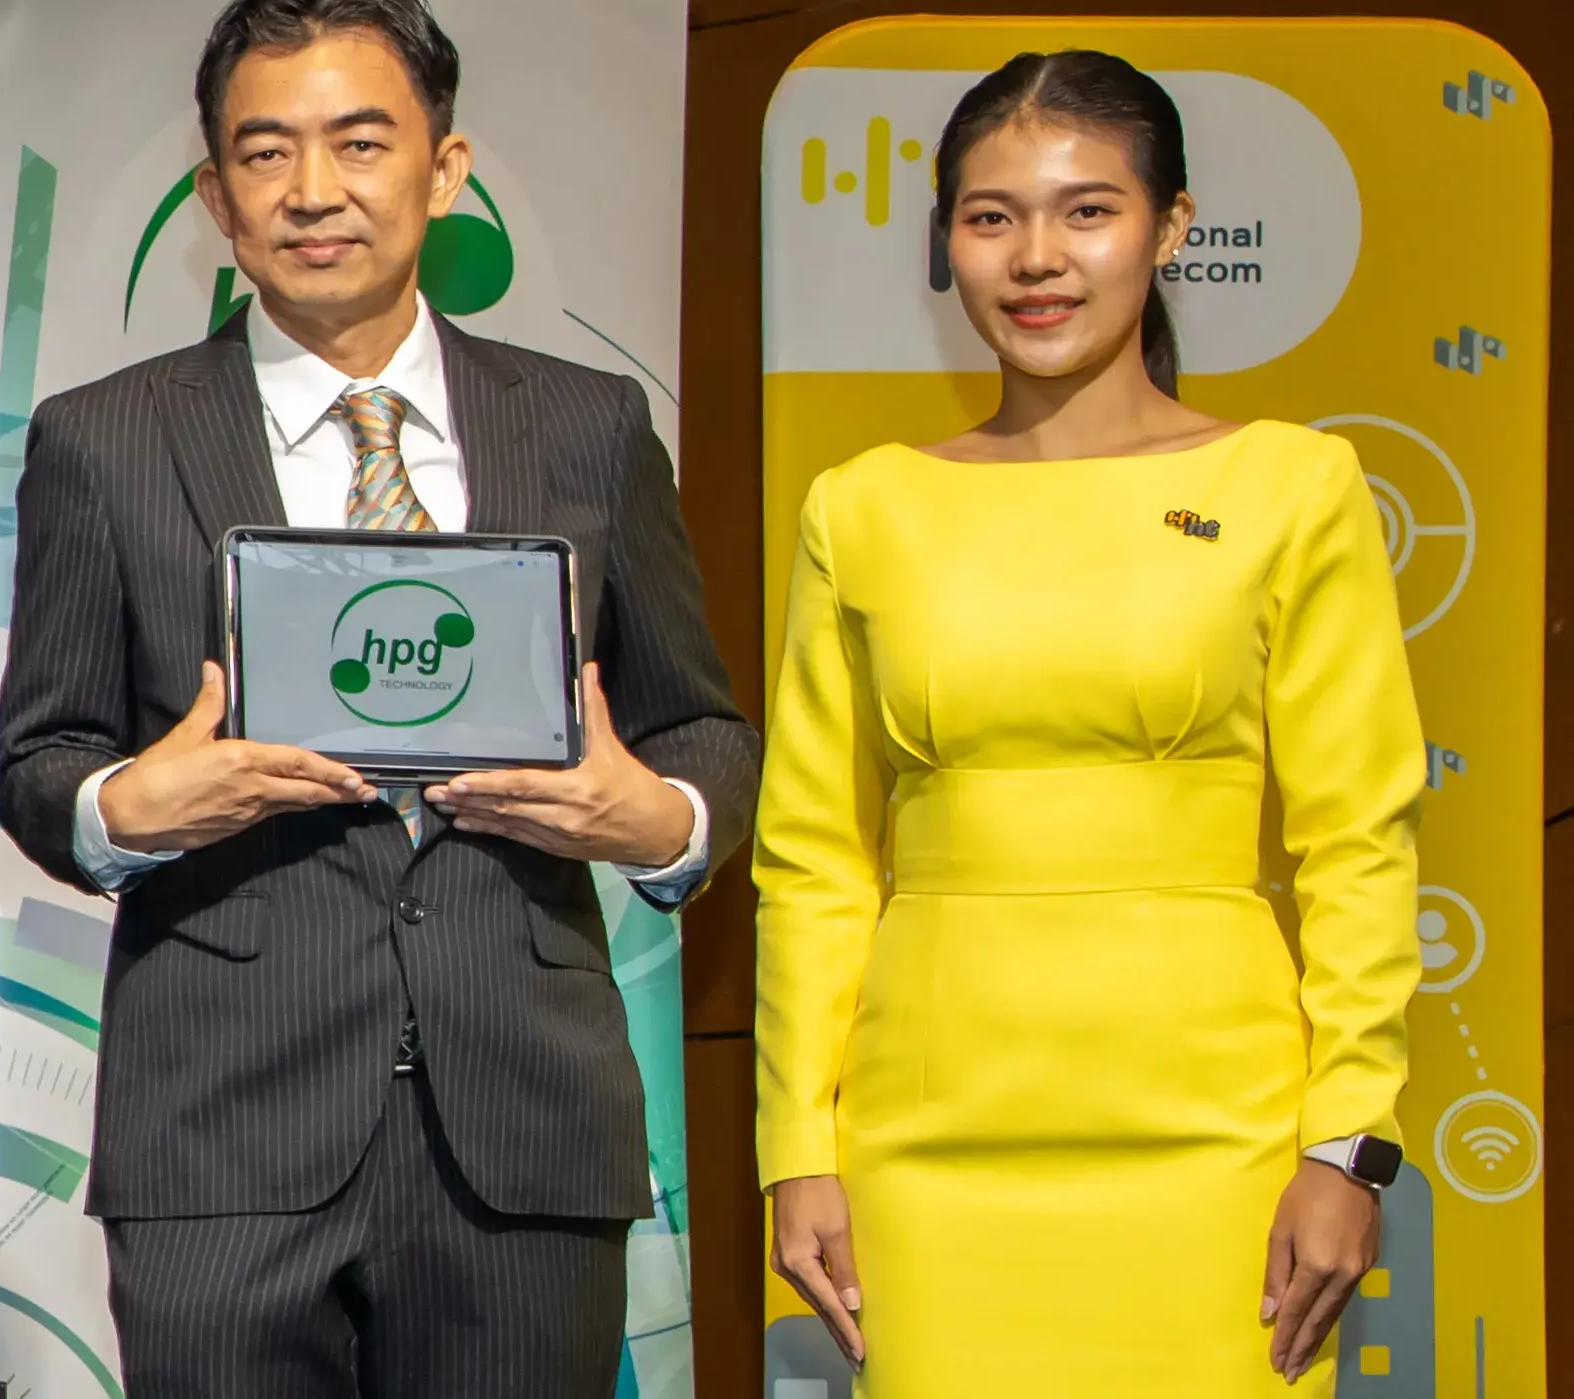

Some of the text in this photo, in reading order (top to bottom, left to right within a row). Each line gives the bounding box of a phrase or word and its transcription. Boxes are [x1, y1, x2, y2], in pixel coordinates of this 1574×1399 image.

[1161, 261, 1262, 283] ecom
[361, 628, 443, 676] hpg
[380, 679, 454, 691] TECHNOLOGY
